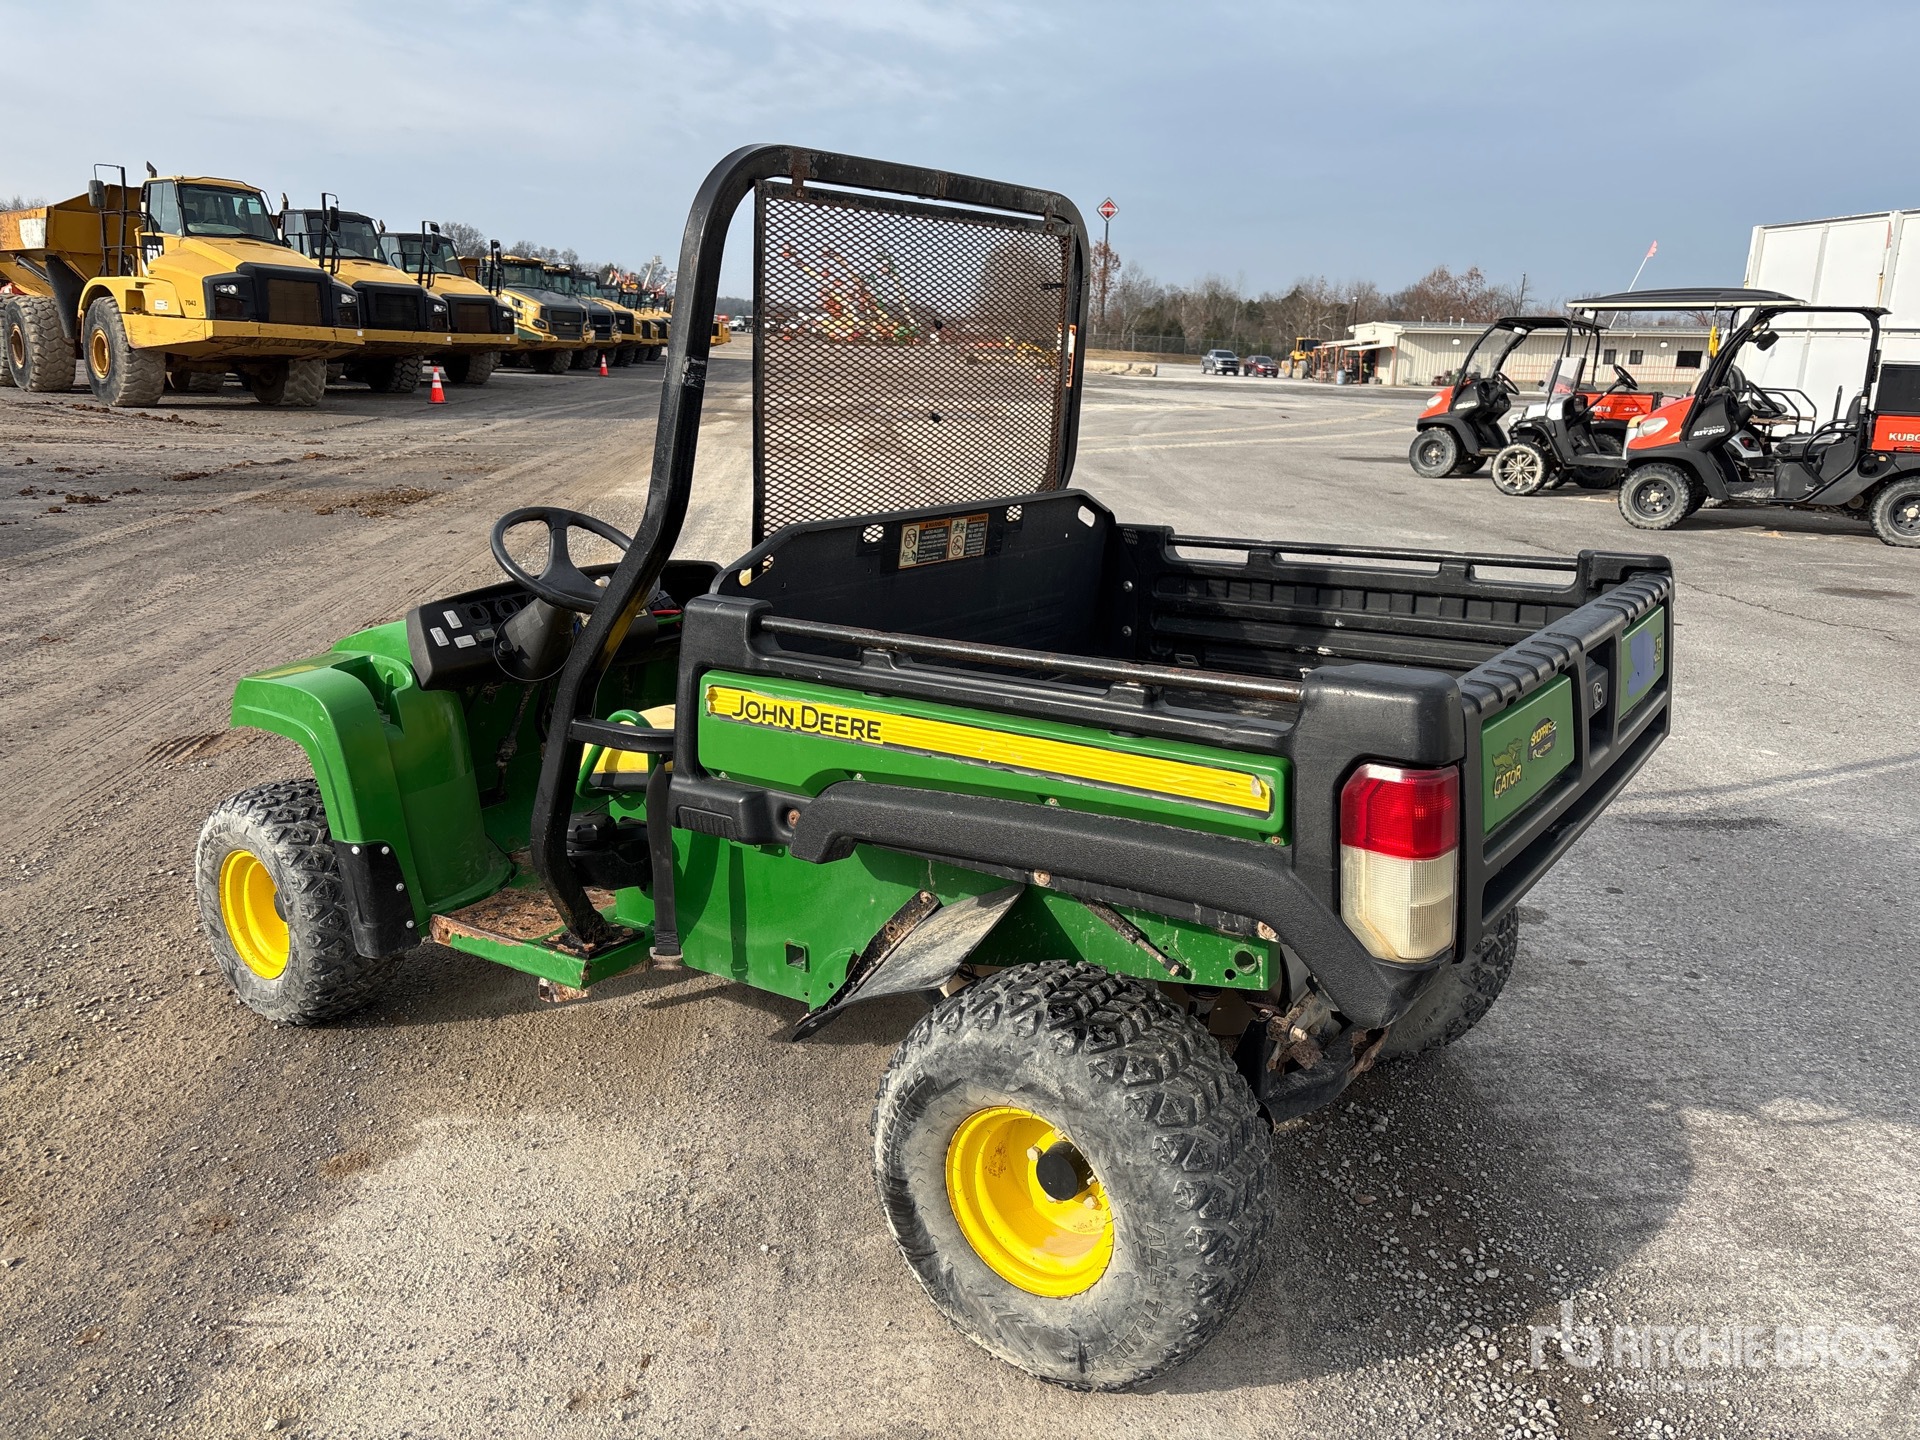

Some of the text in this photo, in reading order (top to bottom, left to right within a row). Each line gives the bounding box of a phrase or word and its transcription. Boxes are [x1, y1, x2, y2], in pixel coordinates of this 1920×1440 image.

[732, 695, 881, 741] JOHN DEERE
[1494, 764, 1522, 796] GATOR
[1146, 1223, 1168, 1286] ALL
[1109, 1298, 1164, 1360] TRAIL
